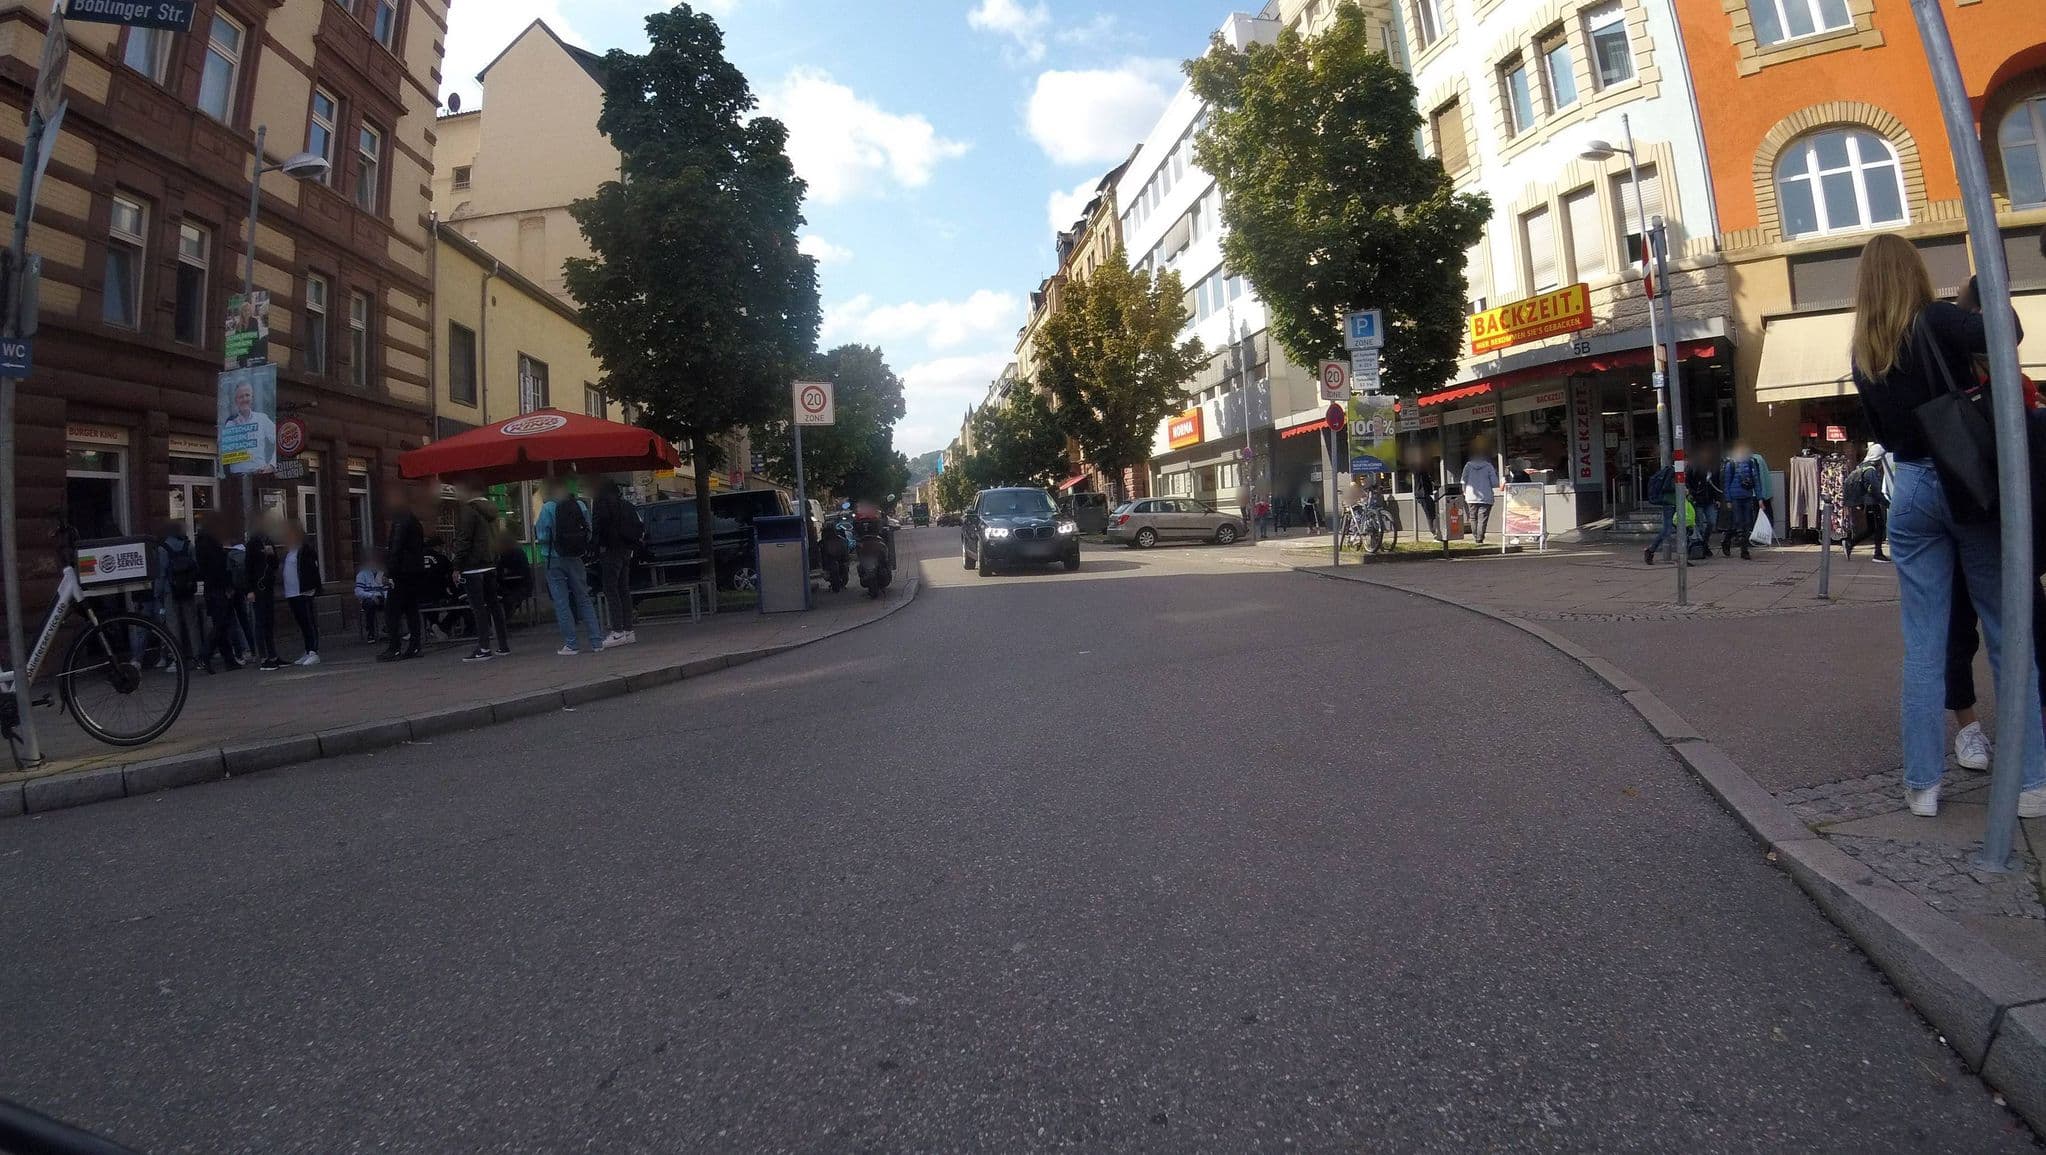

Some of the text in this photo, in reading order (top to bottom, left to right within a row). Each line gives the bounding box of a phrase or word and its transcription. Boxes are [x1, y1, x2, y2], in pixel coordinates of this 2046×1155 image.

[158, 4, 184, 22] Str.
[1475, 291, 1581, 336] BACKZEIT.
[1491, 332, 1526, 346] BEKOMMEN
[1528, 328, 1543, 336] SIE'S
[2, 343, 26, 358] WC
[1573, 341, 1591, 355] 5B
[1327, 371, 1340, 382] 20
[806, 393, 821, 406] 20
[69, 426, 118, 440] BURGER KING
[1172, 420, 1194, 438] NORMA
[117, 558, 145, 568] SERVICE
